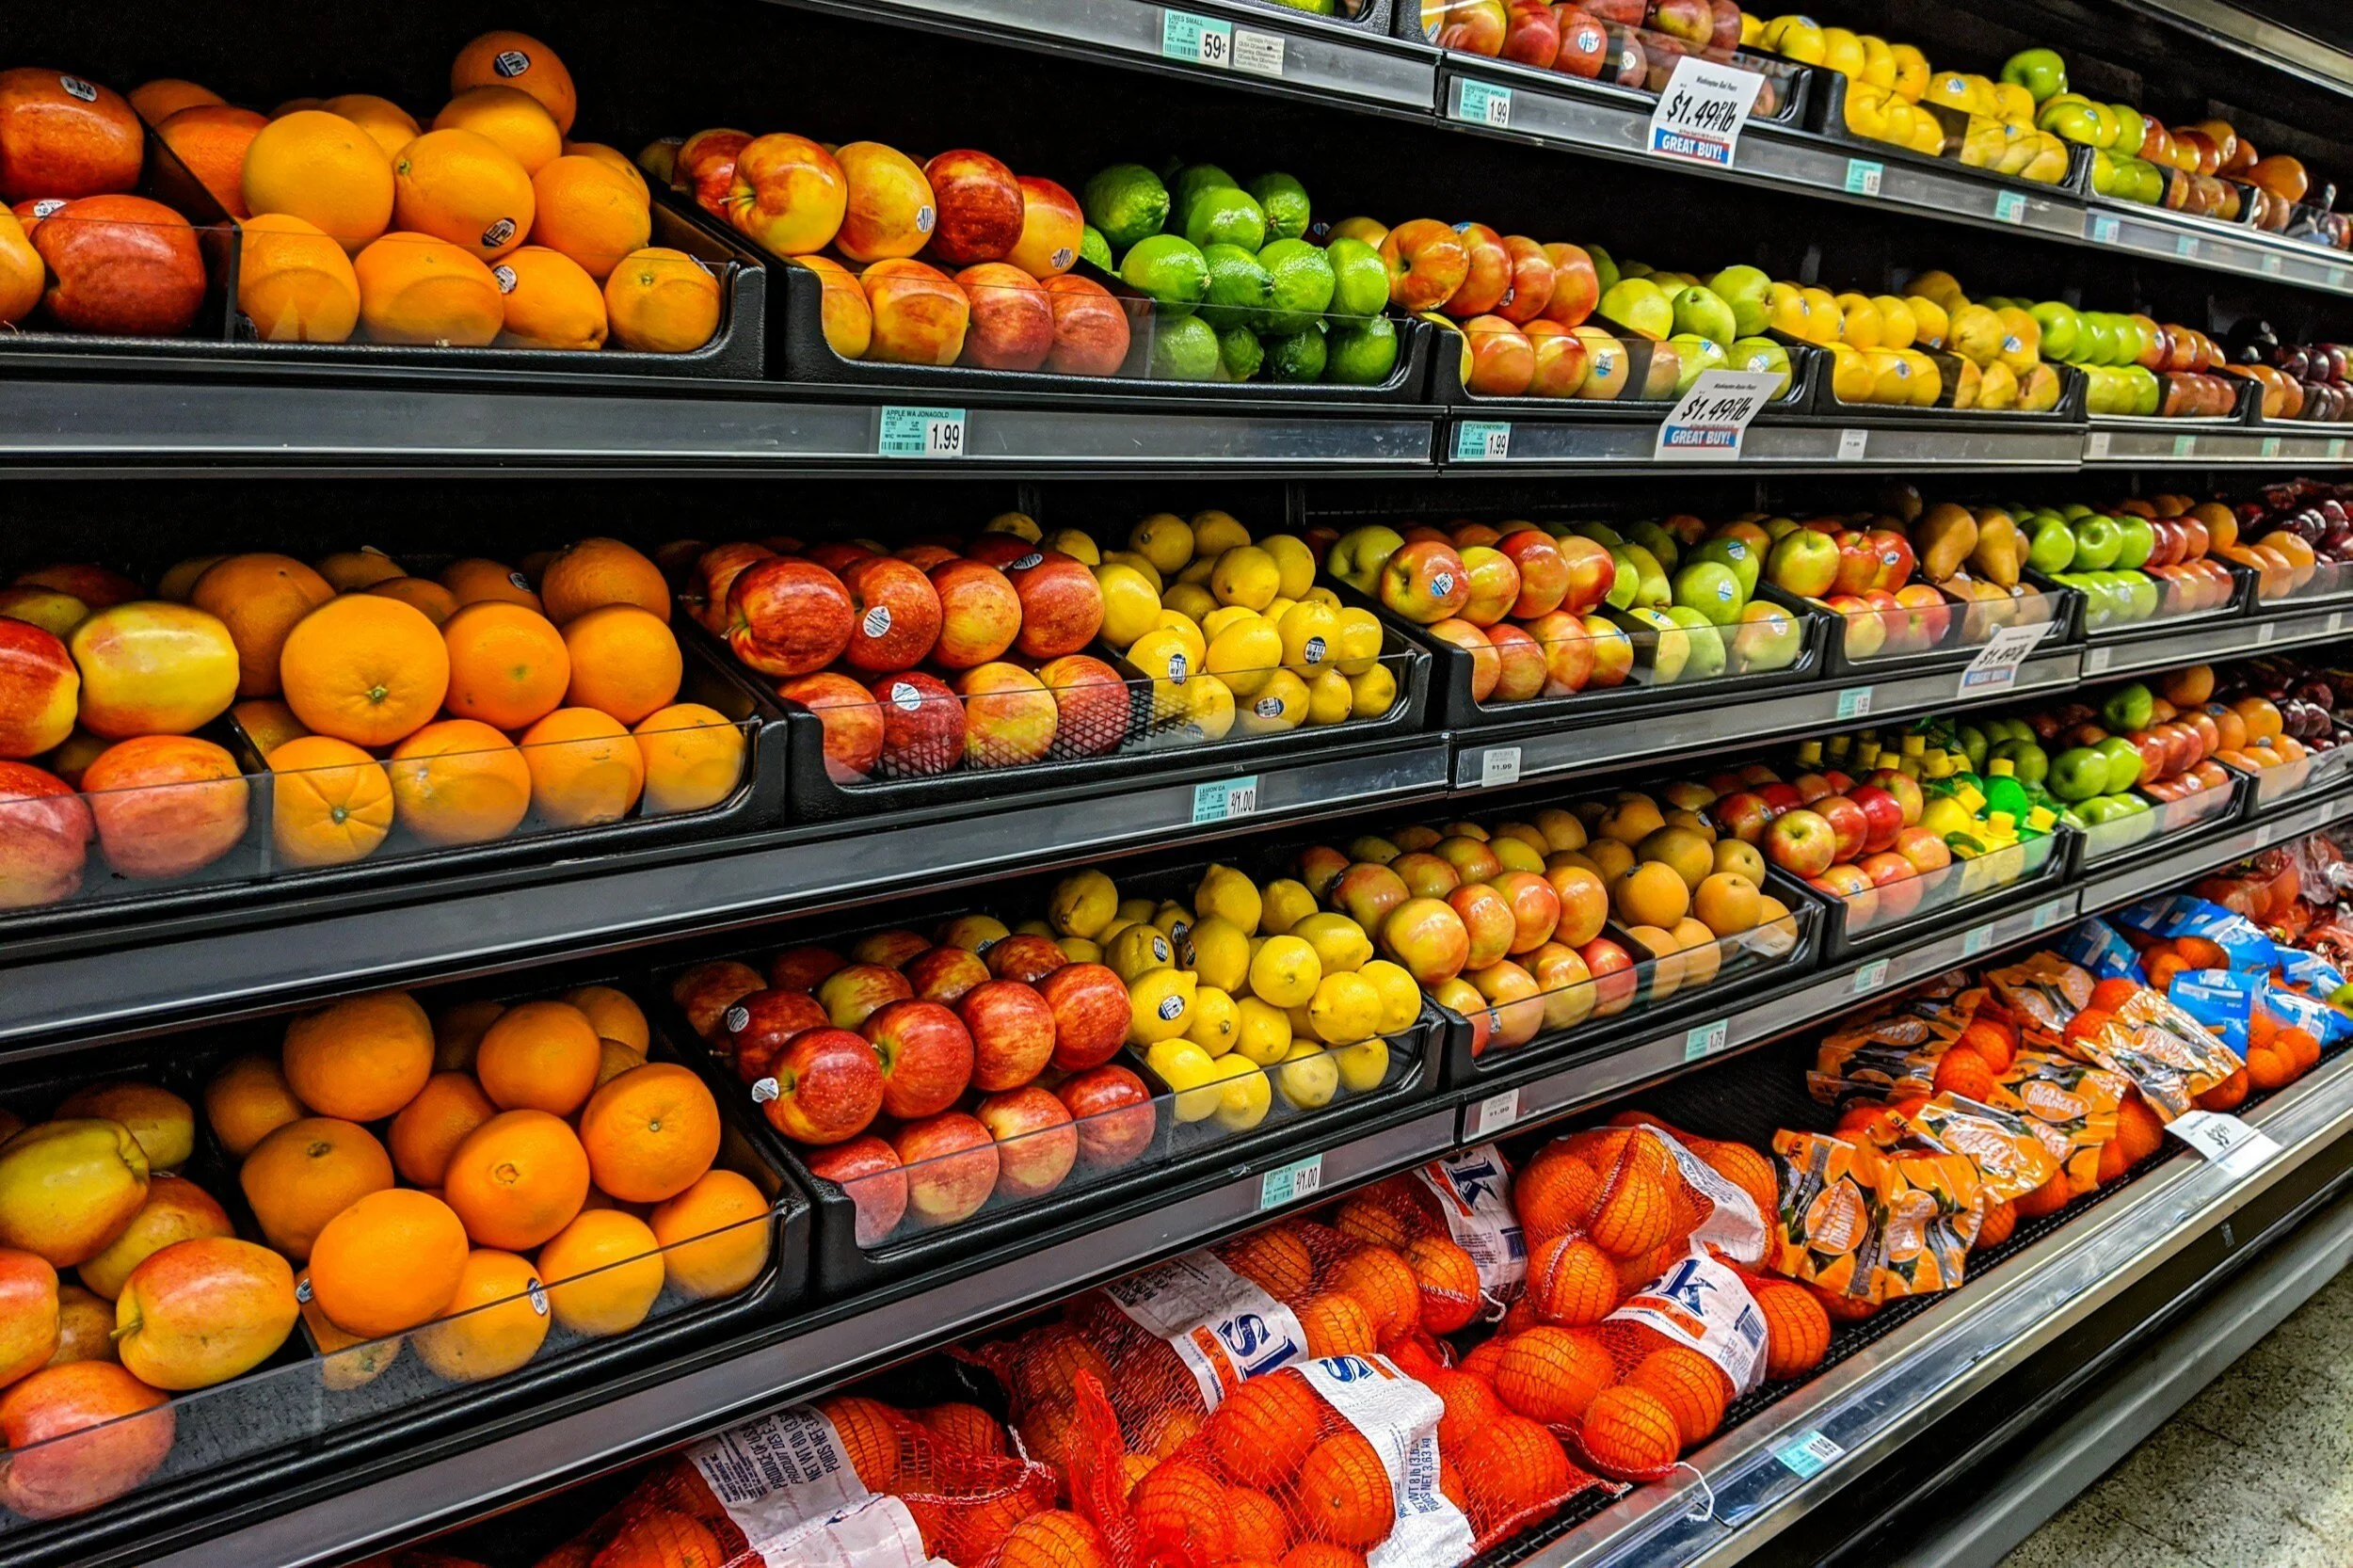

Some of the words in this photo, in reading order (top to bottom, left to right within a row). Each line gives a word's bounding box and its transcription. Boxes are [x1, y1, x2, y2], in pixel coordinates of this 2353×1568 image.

[1169, 13, 1184, 23] LIMES
[1186, 17, 1204, 26] SMALL
[1205, 33, 1226, 59] 59¢
[1490, 100, 1507, 123] 1.99
[1667, 89, 1720, 129] $1.49
[1718, 101, 1737, 133] lb
[1662, 135, 1696, 154] GREAT
[1698, 141, 1723, 160] BUY!
[1680, 395, 1736, 422] $1.49
[932, 424, 960, 450] 1.99
[1489, 434, 1506, 455] 1.99
[1672, 430, 1705, 445] GREAT
[1706, 430, 1730, 445] BUY!
[1231, 791, 1254, 814] 2/1.00
[1446, 1151, 1499, 1208] K
[767, 1432, 785, 1449] DES
[808, 1427, 828, 1448] NET
[1420, 1437, 1433, 1449] kg
[753, 1444, 767, 1456] OF
[794, 1448, 814, 1466] WT
[816, 1446, 841, 1474] POIDS
[758, 1452, 788, 1490] PRODUCE
[1420, 1450, 1433, 1472] 3.63
[803, 1463, 824, 1483] NET
[1410, 1468, 1421, 1477] lb
[1420, 1474, 1433, 1490] NET
[1408, 1486, 1419, 1502] WT
[1411, 1500, 1431, 1513] NET
